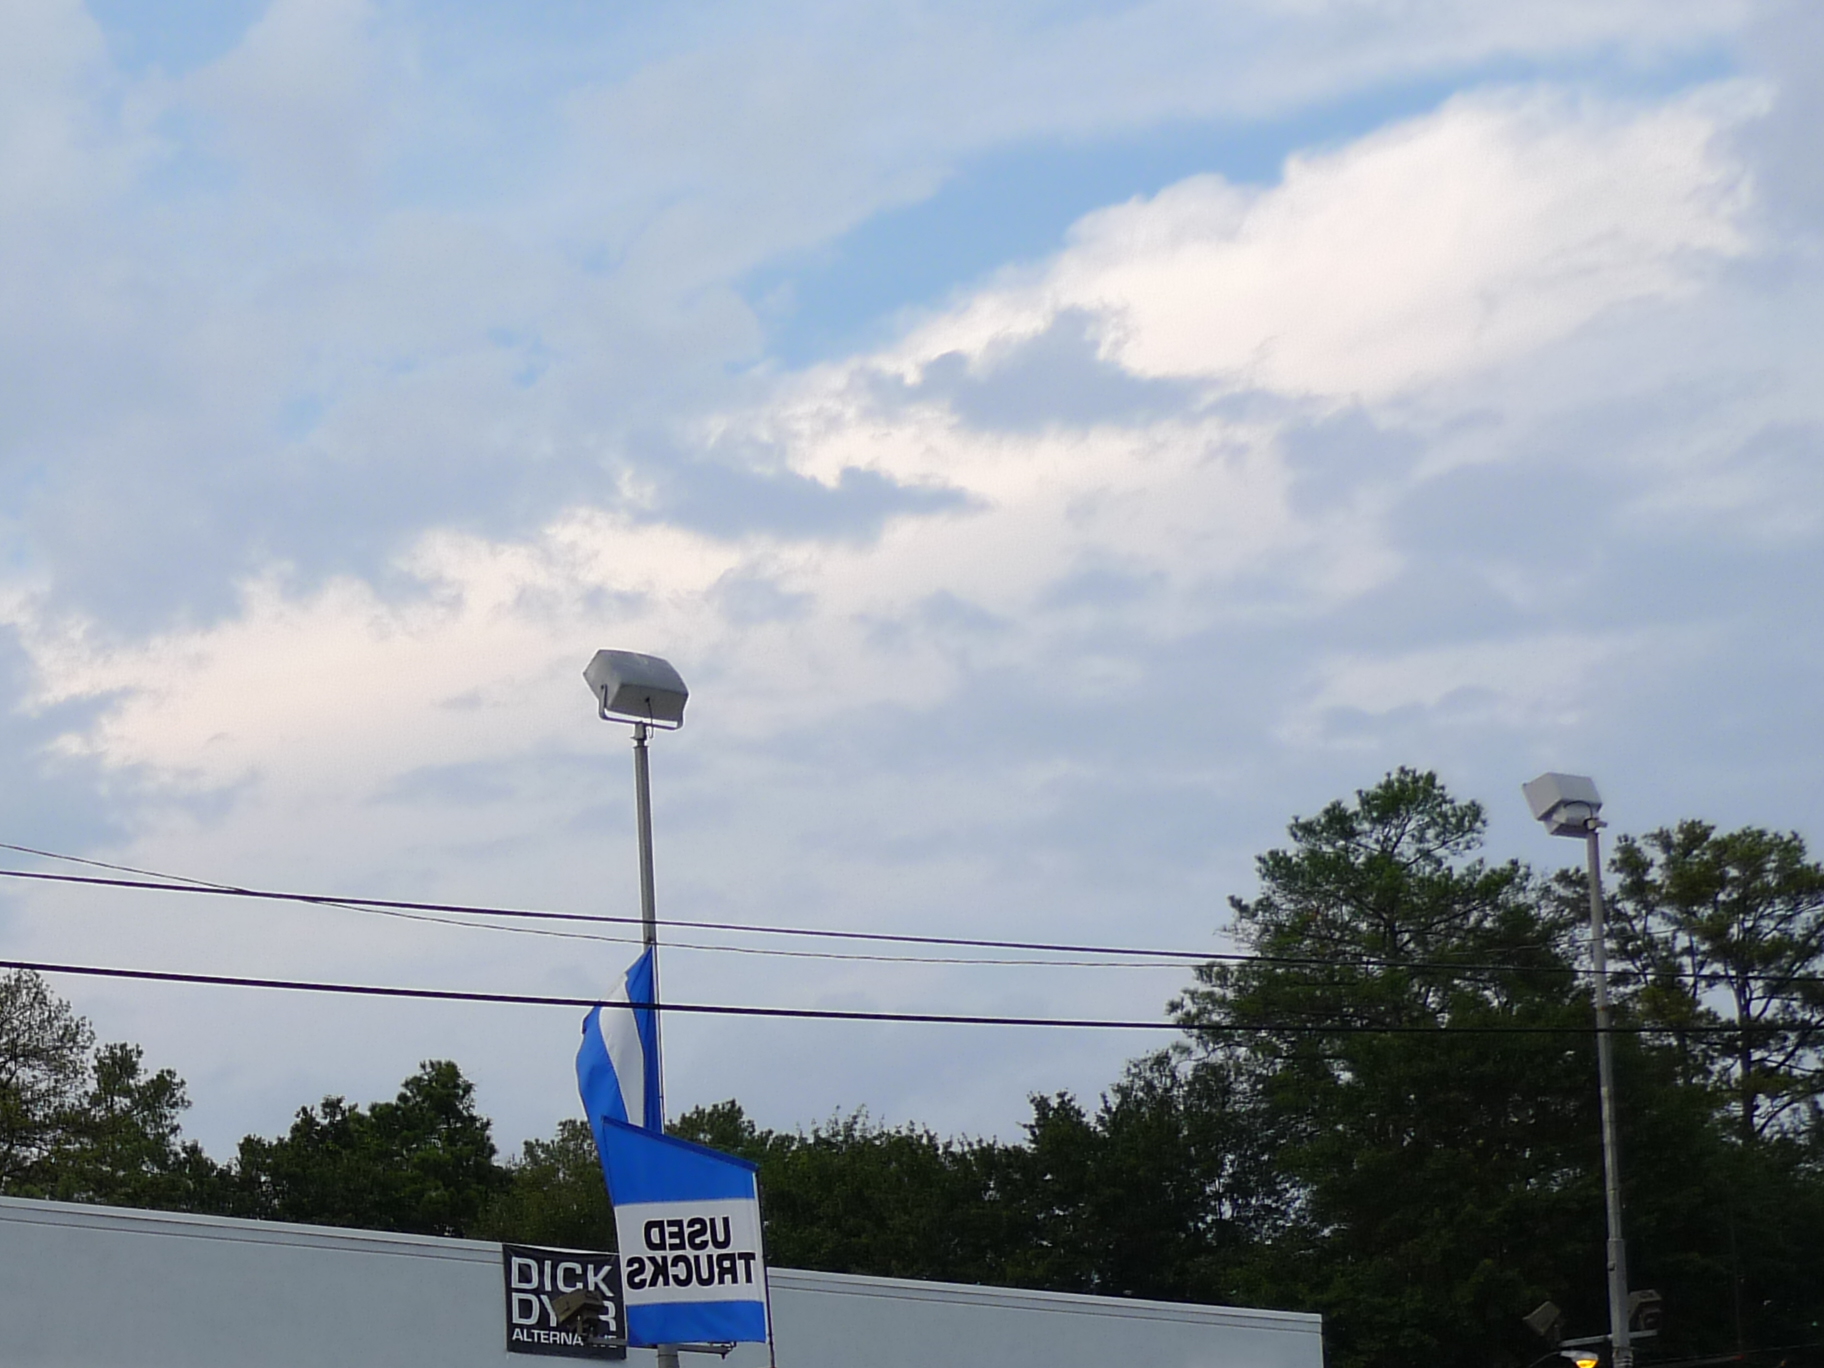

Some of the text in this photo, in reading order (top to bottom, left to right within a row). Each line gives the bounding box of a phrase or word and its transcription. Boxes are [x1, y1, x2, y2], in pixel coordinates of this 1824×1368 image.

[511, 1256, 615, 1297] DICK
[511, 1291, 617, 1332] DYR
[511, 1327, 618, 1348] ALTERNA
